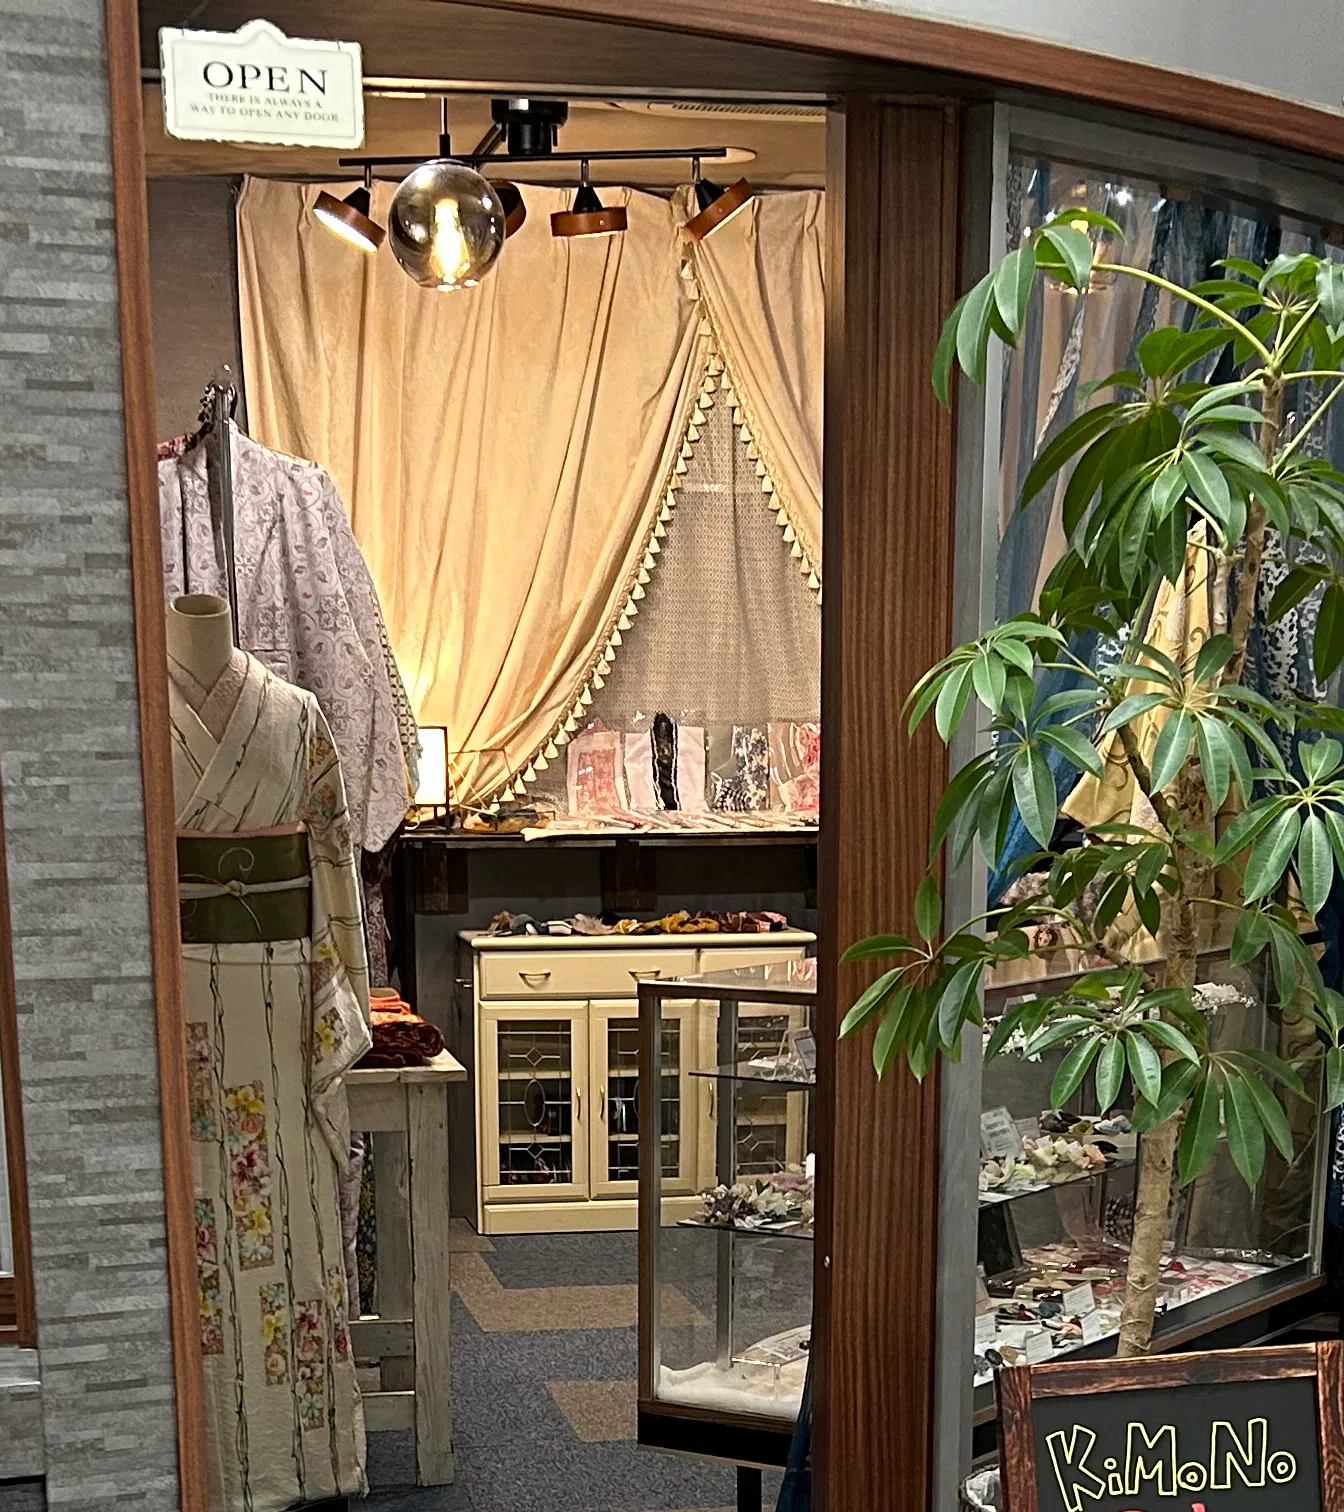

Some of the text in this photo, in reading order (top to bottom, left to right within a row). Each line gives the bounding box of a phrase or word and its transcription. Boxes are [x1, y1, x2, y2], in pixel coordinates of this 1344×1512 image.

[203, 61, 327, 95] OPEN
[208, 92, 246, 105] THERE
[265, 96, 311, 108] ALWAYS
[190, 104, 338, 123] WAY TO OPEN ANY DOOR
